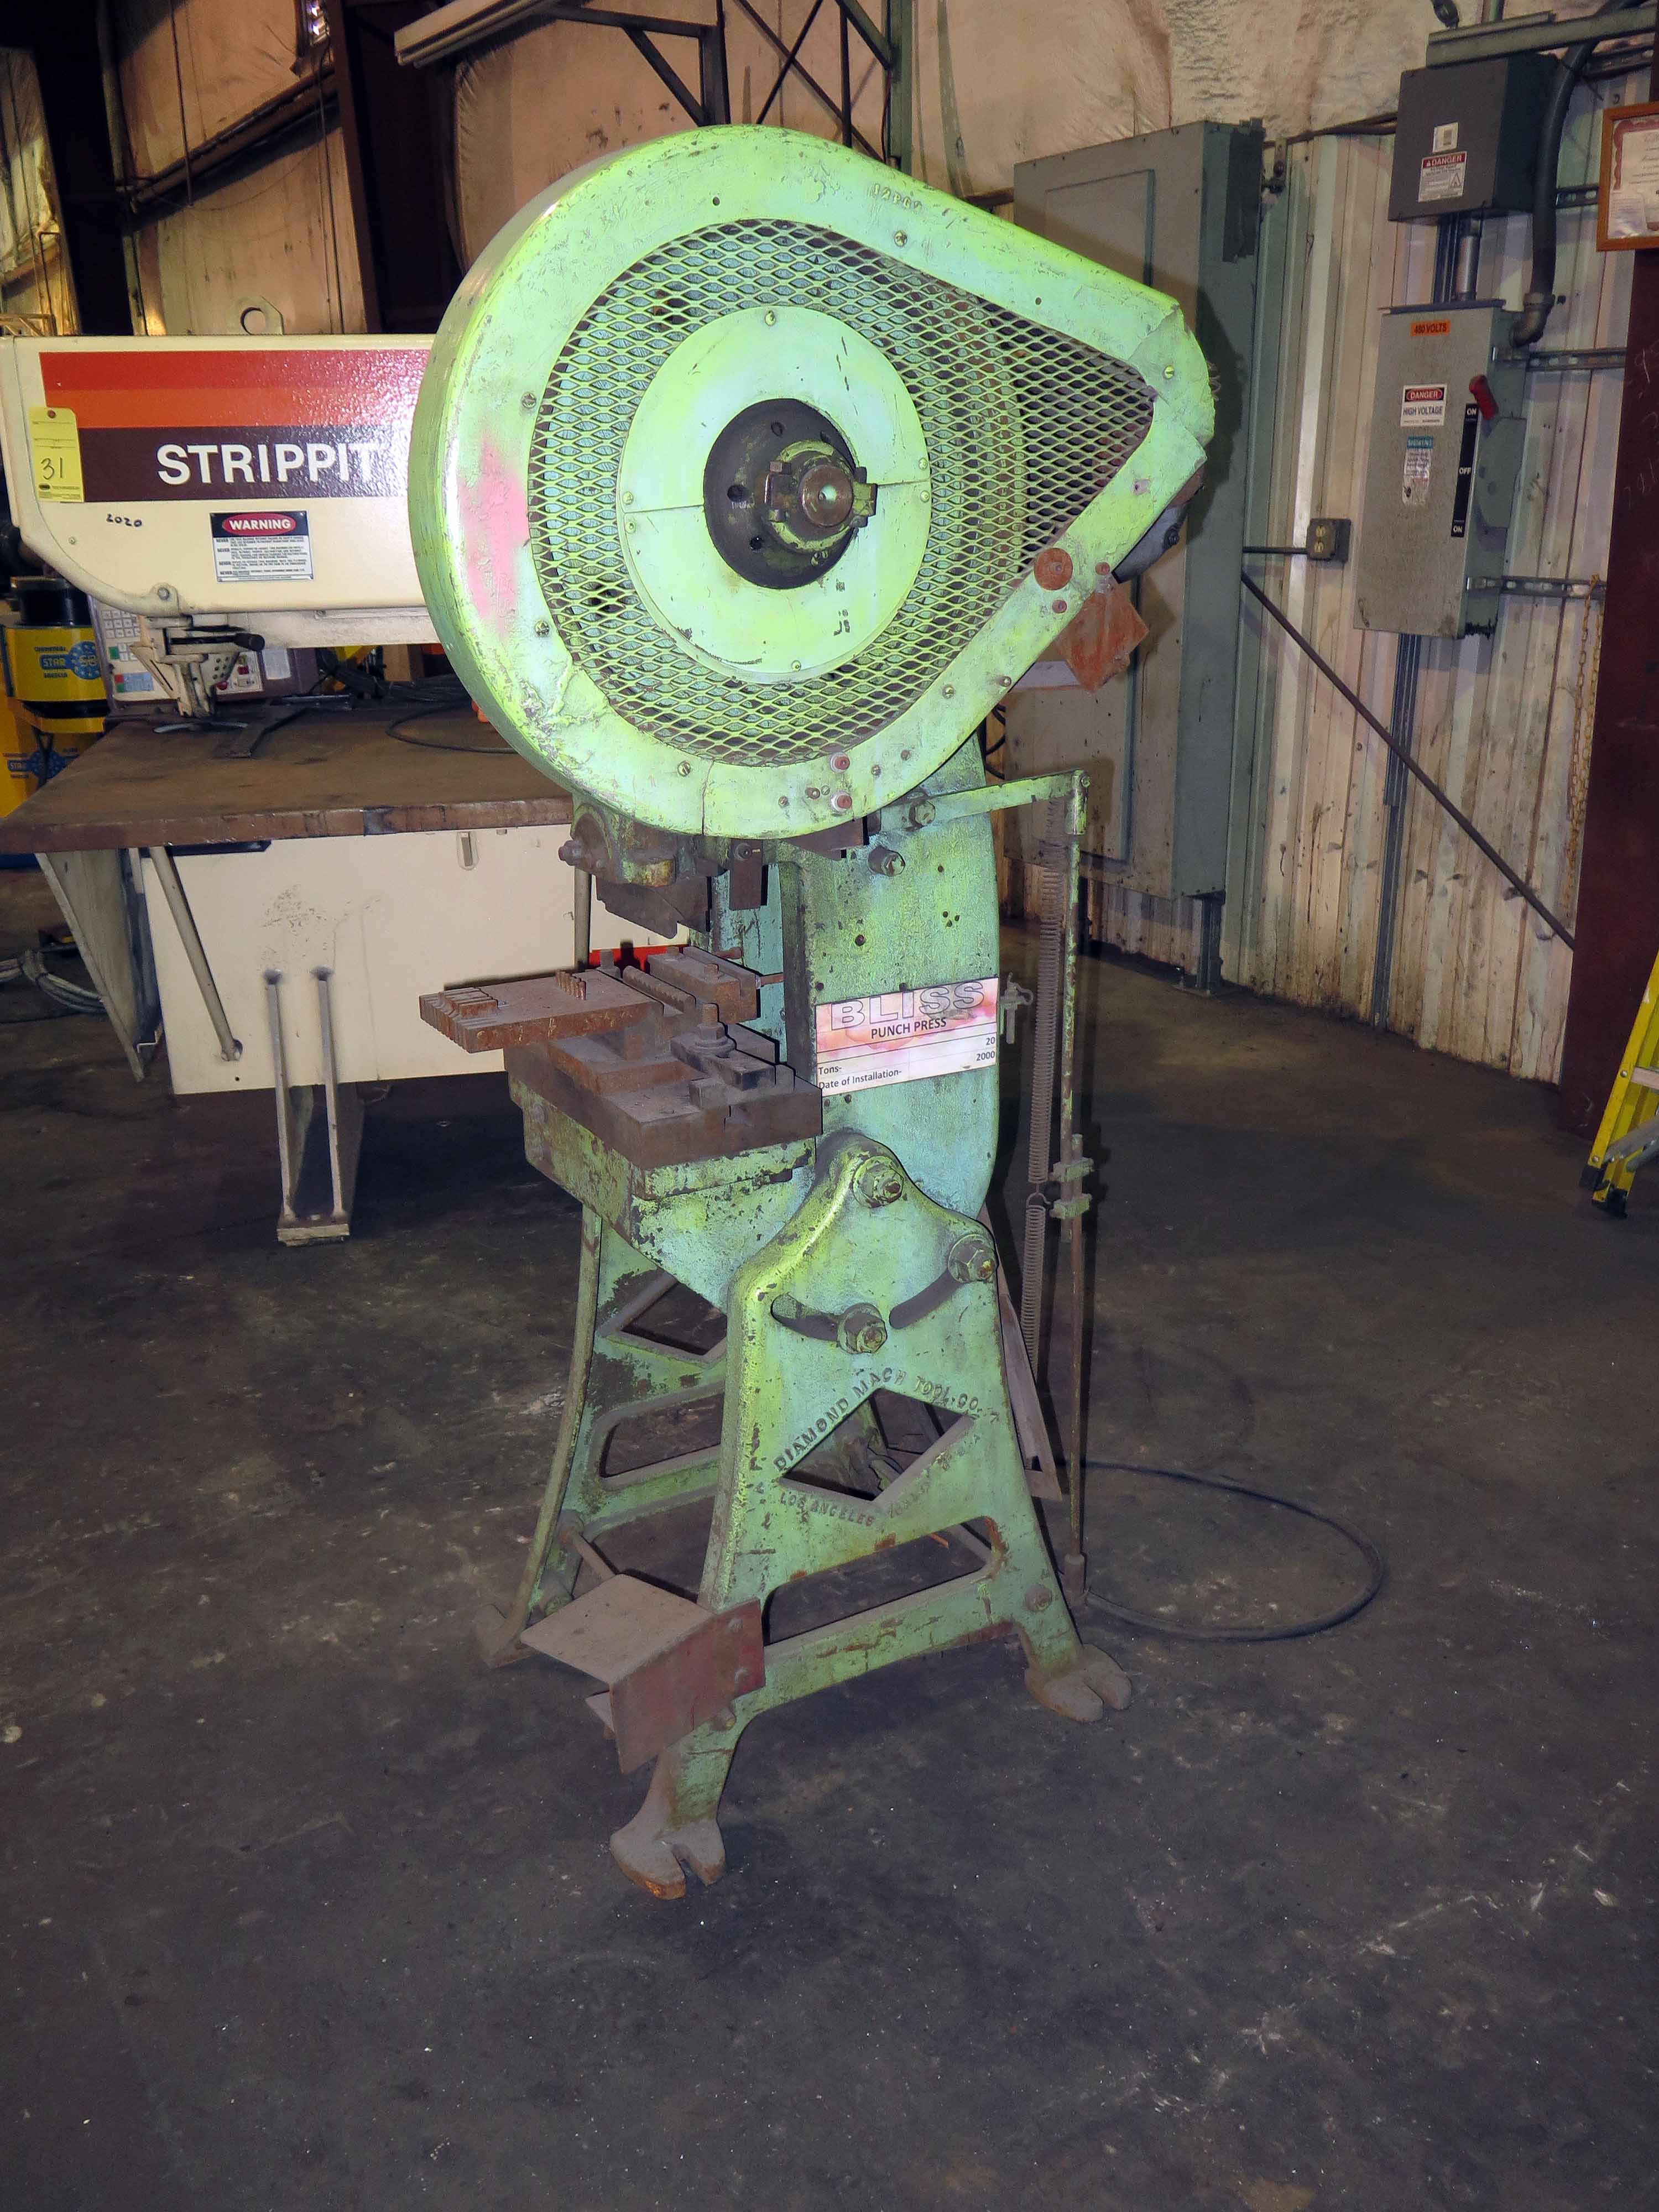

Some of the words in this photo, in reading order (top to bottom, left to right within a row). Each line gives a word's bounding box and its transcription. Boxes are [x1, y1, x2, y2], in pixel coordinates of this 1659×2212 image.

[1432, 155, 1462, 165] DANGER
[1414, 325, 1425, 333] 480
[1426, 322, 1447, 333] VOLTS
[1410, 391, 1438, 399] DANGER
[1403, 406, 1417, 415] HIGH
[1418, 405, 1442, 415] VOLTAGE
[40, 457, 64, 480] 31
[156, 442, 390, 485] STRIPPIT
[1459, 467, 1472, 475] OFF
[229, 519, 291, 530] WARNING
[831, 980, 985, 1030] BLISS
[871, 1022, 910, 1039] PUNCH
[914, 1018, 947, 1032] PRESS
[818, 1065, 842, 1075] Tons-
[985, 1036, 995, 1046] 20
[818, 1079, 838, 1090] Date
[841, 1077, 851, 1086] of
[852, 1068, 902, 1084] Installation-
[976, 1050, 995, 1061] 2000
[773, 1397, 849, 1472] DIAMOND
